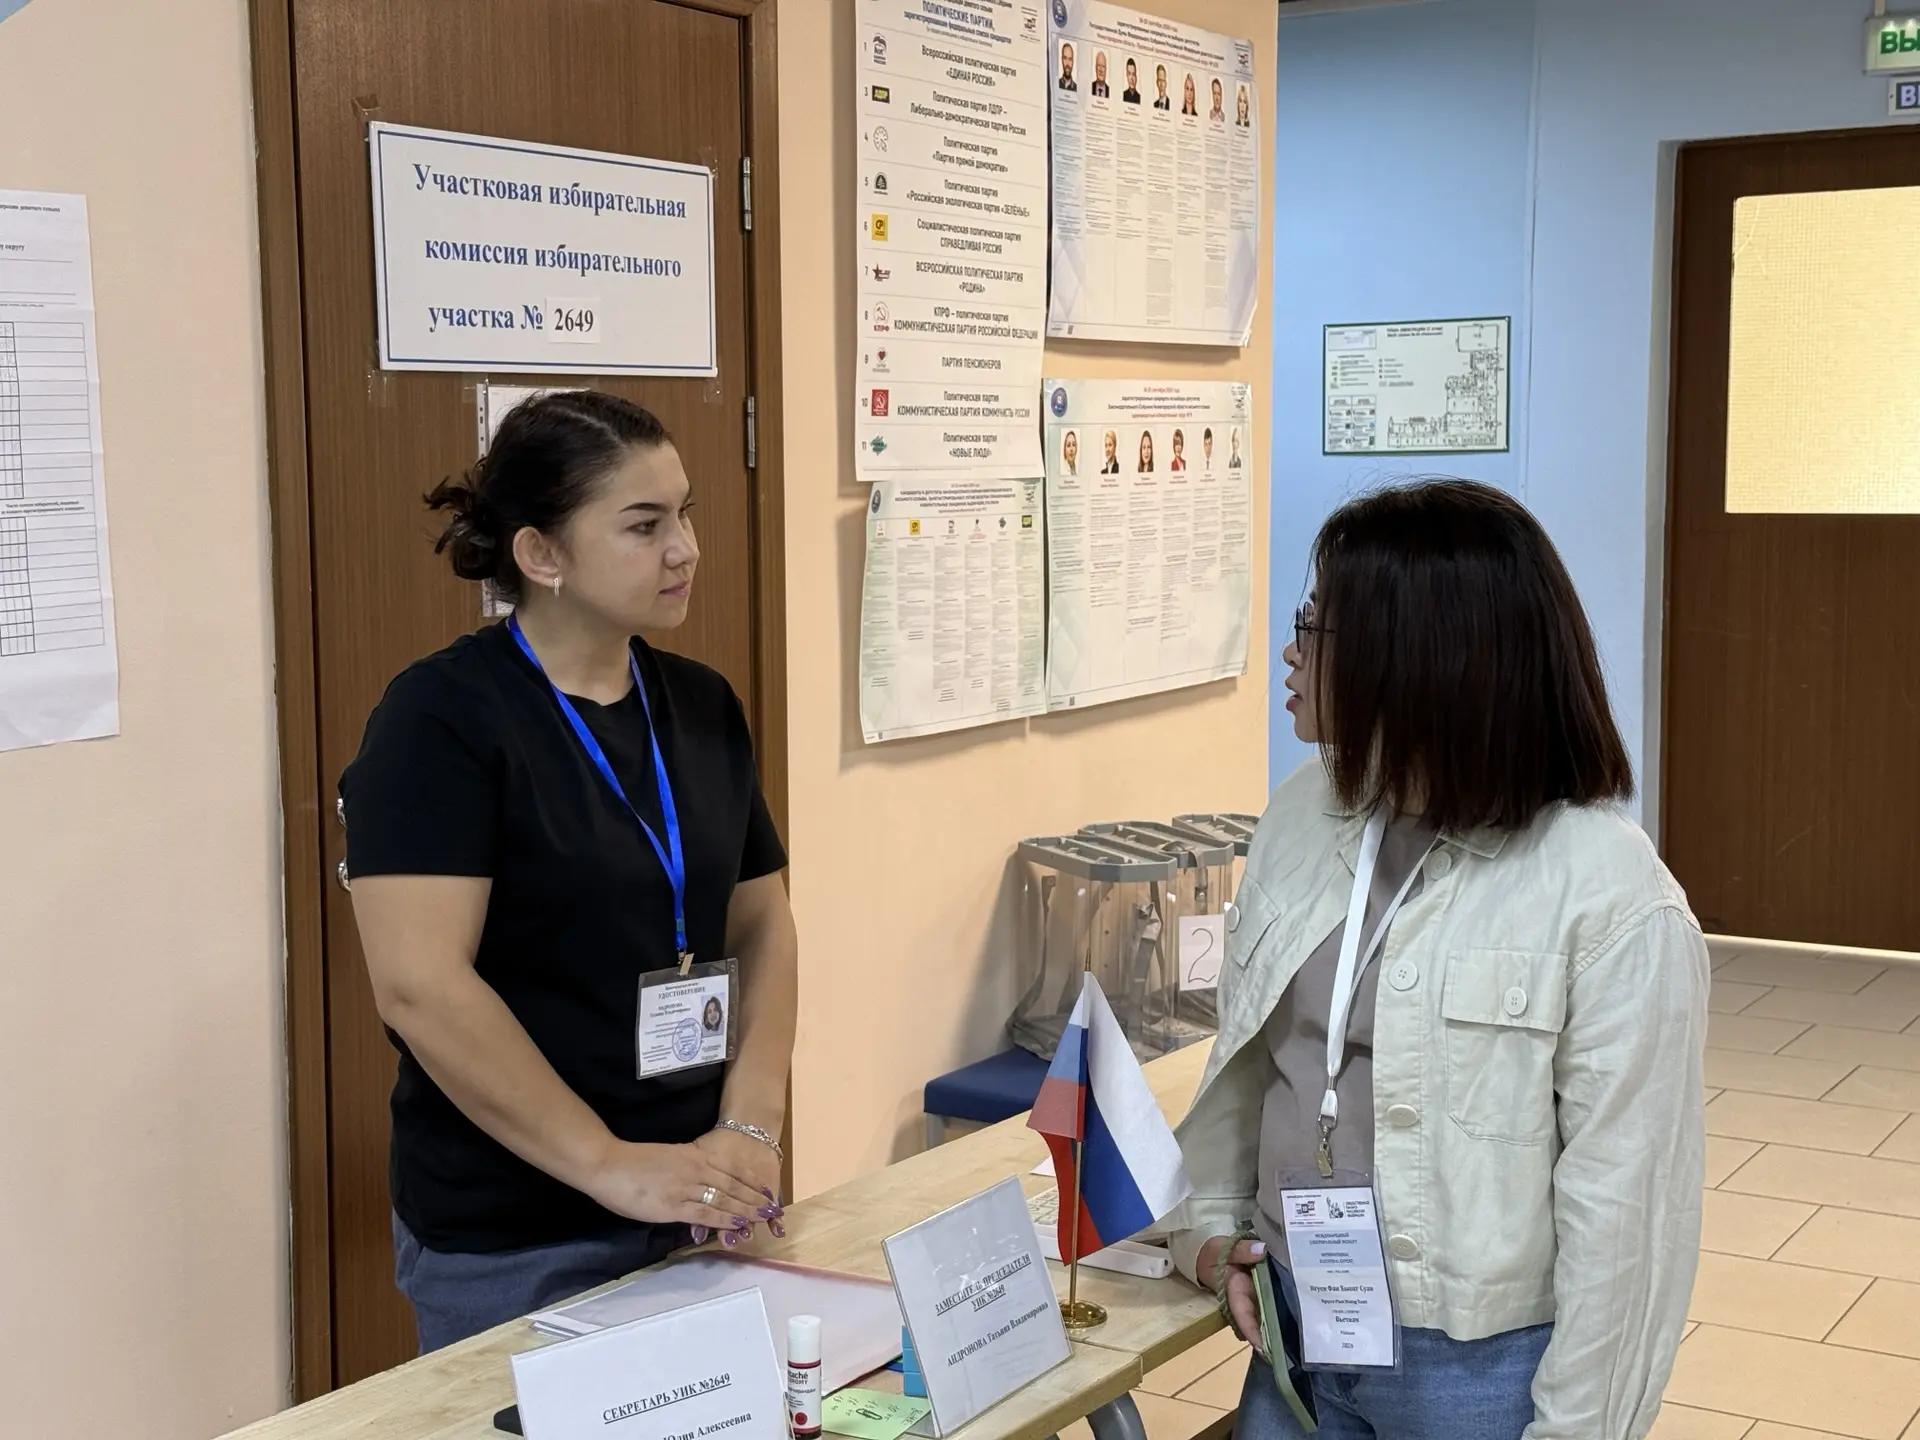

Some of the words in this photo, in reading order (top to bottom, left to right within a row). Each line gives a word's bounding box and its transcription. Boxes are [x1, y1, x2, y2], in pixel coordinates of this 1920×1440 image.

[922, 1, 969, 23] ПОЛИТИЧЕСКИЕ
[863, 41, 867, 51] 1
[922, 44, 964, 64] Всероссийская
[964, 55, 1000, 73] политическая
[1000, 63, 1017, 77] партия
[946, 67, 971, 82] «ЕДИНАЯ
[971, 72, 996, 87] РОССИЯ»
[864, 86, 869, 96] 3
[933, 91, 969, 108] Политическая
[970, 99, 987, 112] партия
[988, 102, 1003, 115] ЛДПР
[1901, 84, 1920, 107] В
[910, 102, 990, 129] Либерально-демократическая
[990, 121, 1008, 134] партия
[1009, 122, 1026, 136] России
[944, 136, 979, 153] Политическая
[980, 145, 998, 156] партия
[933, 150, 955, 165] «Партия
[956, 156, 975, 168] прямой
[975, 160, 1008, 172] демократии»
[413, 163, 542, 203] Участковая
[549, 182, 686, 218] избирательная
[864, 176, 869, 187] 5
[944, 179, 980, 194] Политическая
[981, 187, 998, 198] партия
[906, 190, 944, 205] «Российская
[945, 197, 982, 210] экологическая
[983, 203, 1000, 214] партия
[917, 218, 969, 235] Социалистическая
[970, 227, 1003, 241] политическая
[1004, 231, 1022, 243] партия
[940, 237, 982, 252] СПРАВЕДЛИВАЯ
[982, 241, 1002, 254] РОССИЯ
[425, 239, 528, 266] комиссия
[535, 244, 681, 277] избирательного
[916, 260, 963, 277] ВСЕРОССИЙСКАЯ
[964, 268, 1003, 281] ПОЛИТИЧЕСКАЯ
[1004, 272, 1024, 283] ПАРТИЯ
[959, 281, 986, 293] «РОДИНА»
[428, 305, 514, 332] участка
[520, 305, 543, 330] №
[554, 308, 594, 332] 2649
[934, 306, 950, 318] КПРФ
[956, 310, 991, 321] политическая
[992, 313, 1009, 323] партия
[894, 319, 955, 333] КОММУНИСТИЧЕСКАЯ
[956, 325, 977, 336] ПАРТИЯ
[978, 325, 1011, 338] РОССИЙСКОЙ
[1011, 328, 1038, 340] ФЕДЕРАЦИИ
[942, 356, 963, 368] ПАРТИЯ
[963, 357, 1001, 370] ПЕНСИОНЕРОВ
[944, 391, 981, 402] Политическая
[982, 394, 999, 404] партия
[897, 405, 959, 417] КОММУНИСТИЧЕСКАЯ
[960, 406, 981, 417] ПАРТИЯ
[943, 432, 981, 443] Политическая
[949, 447, 972, 458] «НОВЫЕ
[1188, 928, 1216, 983] 2
[935, 1281, 982, 1313] ЗАМЕСТИТЕЛЬ
[982, 1253, 1031, 1286] ПРЕДСЕДАТЕЛЯ
[971, 1294, 986, 1310] УИК
[947, 1337, 987, 1367] АНДРОНОВА
[987, 1324, 1011, 1343] Татьяна
[1009, 1302, 1049, 1330] Владимировна
[602, 1391, 671, 1422] СЕКРЕТАРЬ
[672, 1384, 697, 1402] УИК
[698, 1373, 731, 1393] №2649
[697, 1412, 752, 1438] Алексеевна
